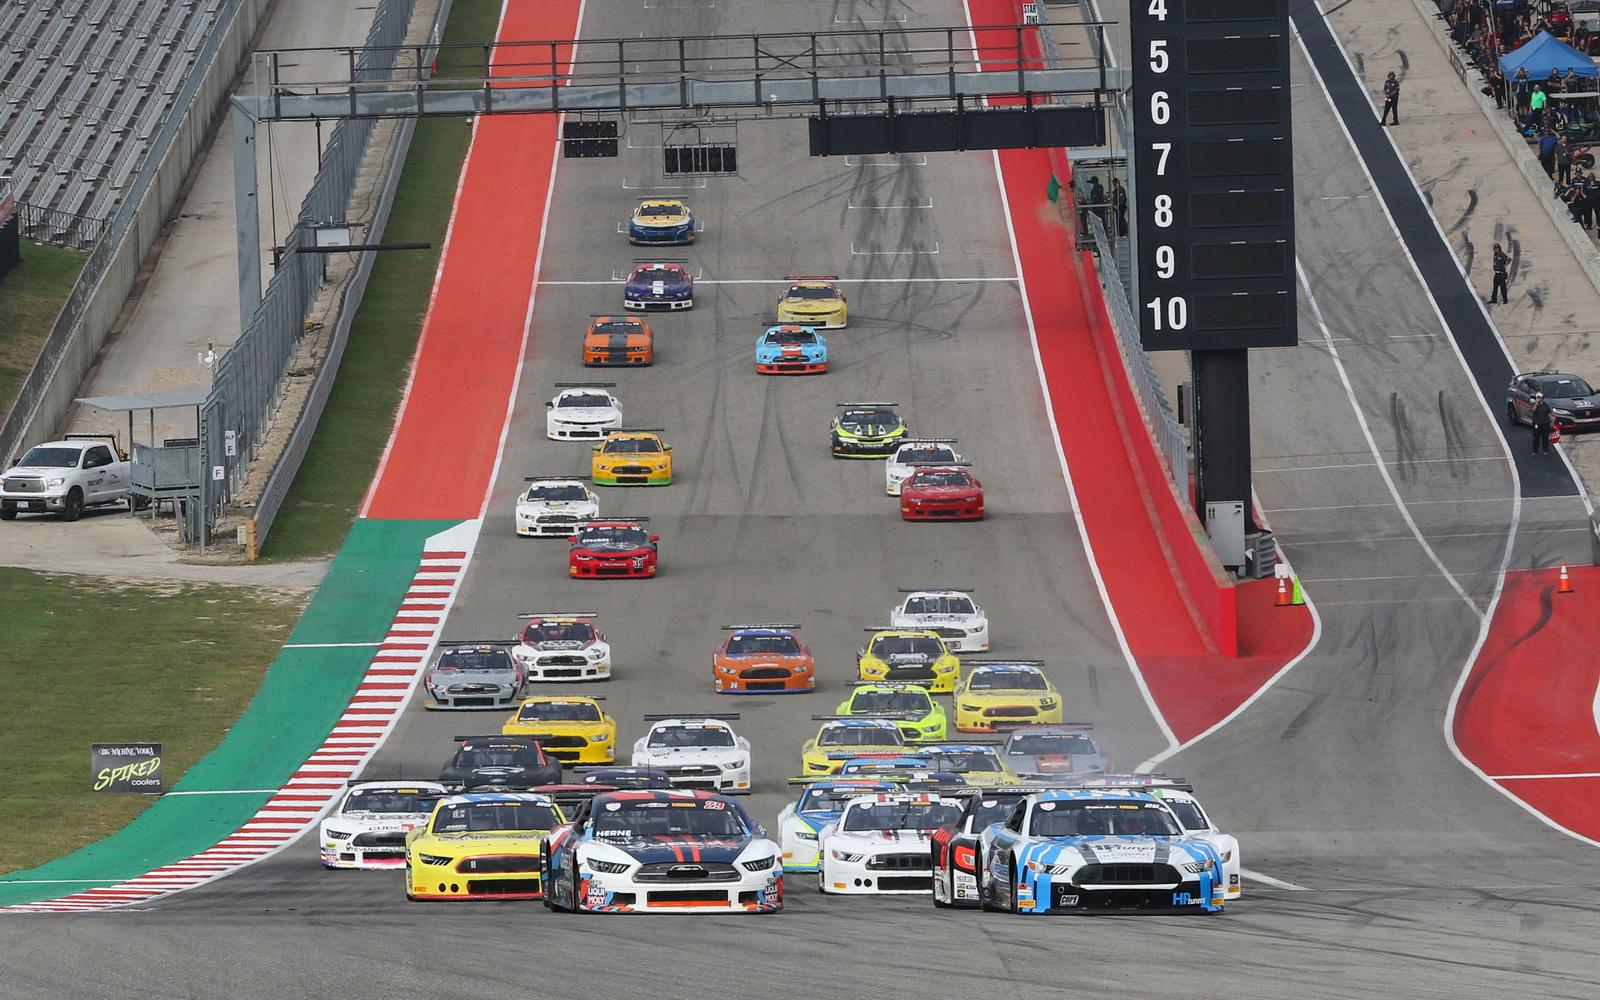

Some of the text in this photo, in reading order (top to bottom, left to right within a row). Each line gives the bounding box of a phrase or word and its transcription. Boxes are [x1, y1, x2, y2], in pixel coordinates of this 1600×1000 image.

[1149, 0, 1167, 20] 4
[1150, 40, 1168, 73] 5
[1151, 91, 1170, 124] 6
[1152, 143, 1171, 176] 7
[1154, 195, 1173, 227] 8
[1156, 246, 1175, 279] 9
[1147, 297, 1187, 330] 10
[94, 757, 160, 790] SPIKED
[131, 778, 160, 786] coolers
[596, 829, 632, 837] HERNE
